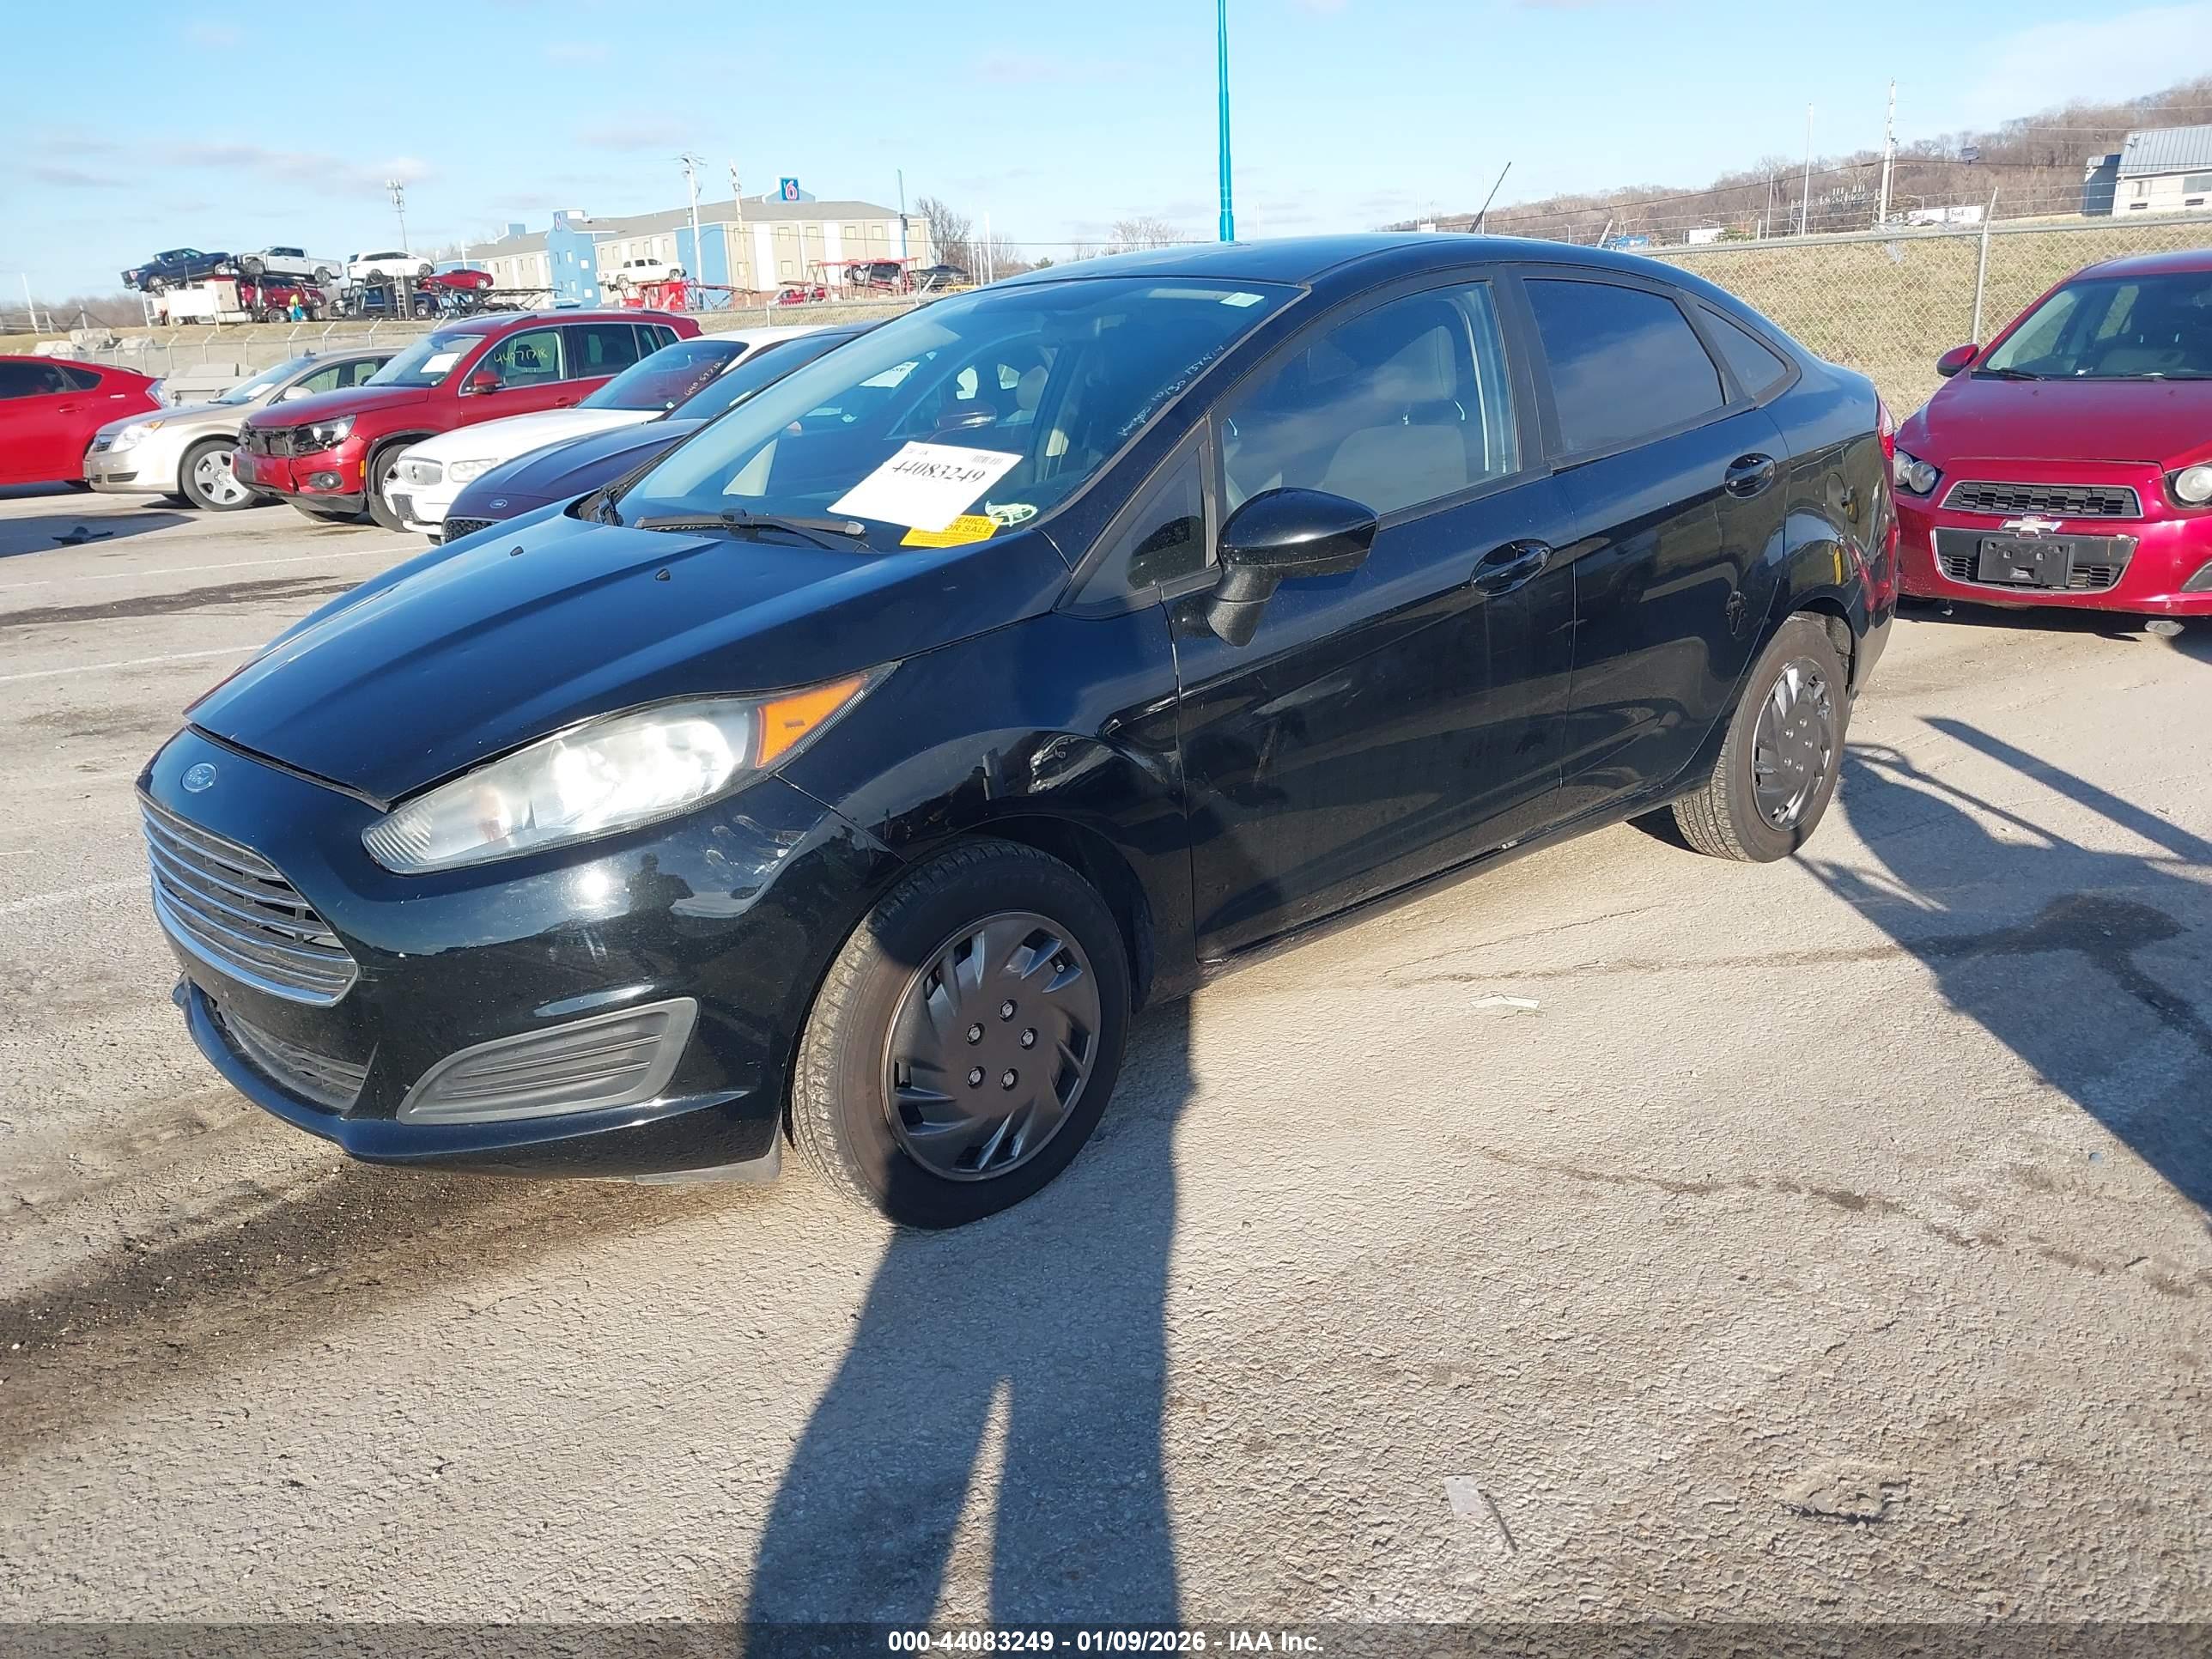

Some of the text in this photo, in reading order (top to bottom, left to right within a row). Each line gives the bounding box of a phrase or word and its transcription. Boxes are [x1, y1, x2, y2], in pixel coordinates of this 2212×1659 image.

[785, 179, 798, 200] 6
[892, 459, 987, 483] 44083249
[963, 525, 994, 534] SALE
